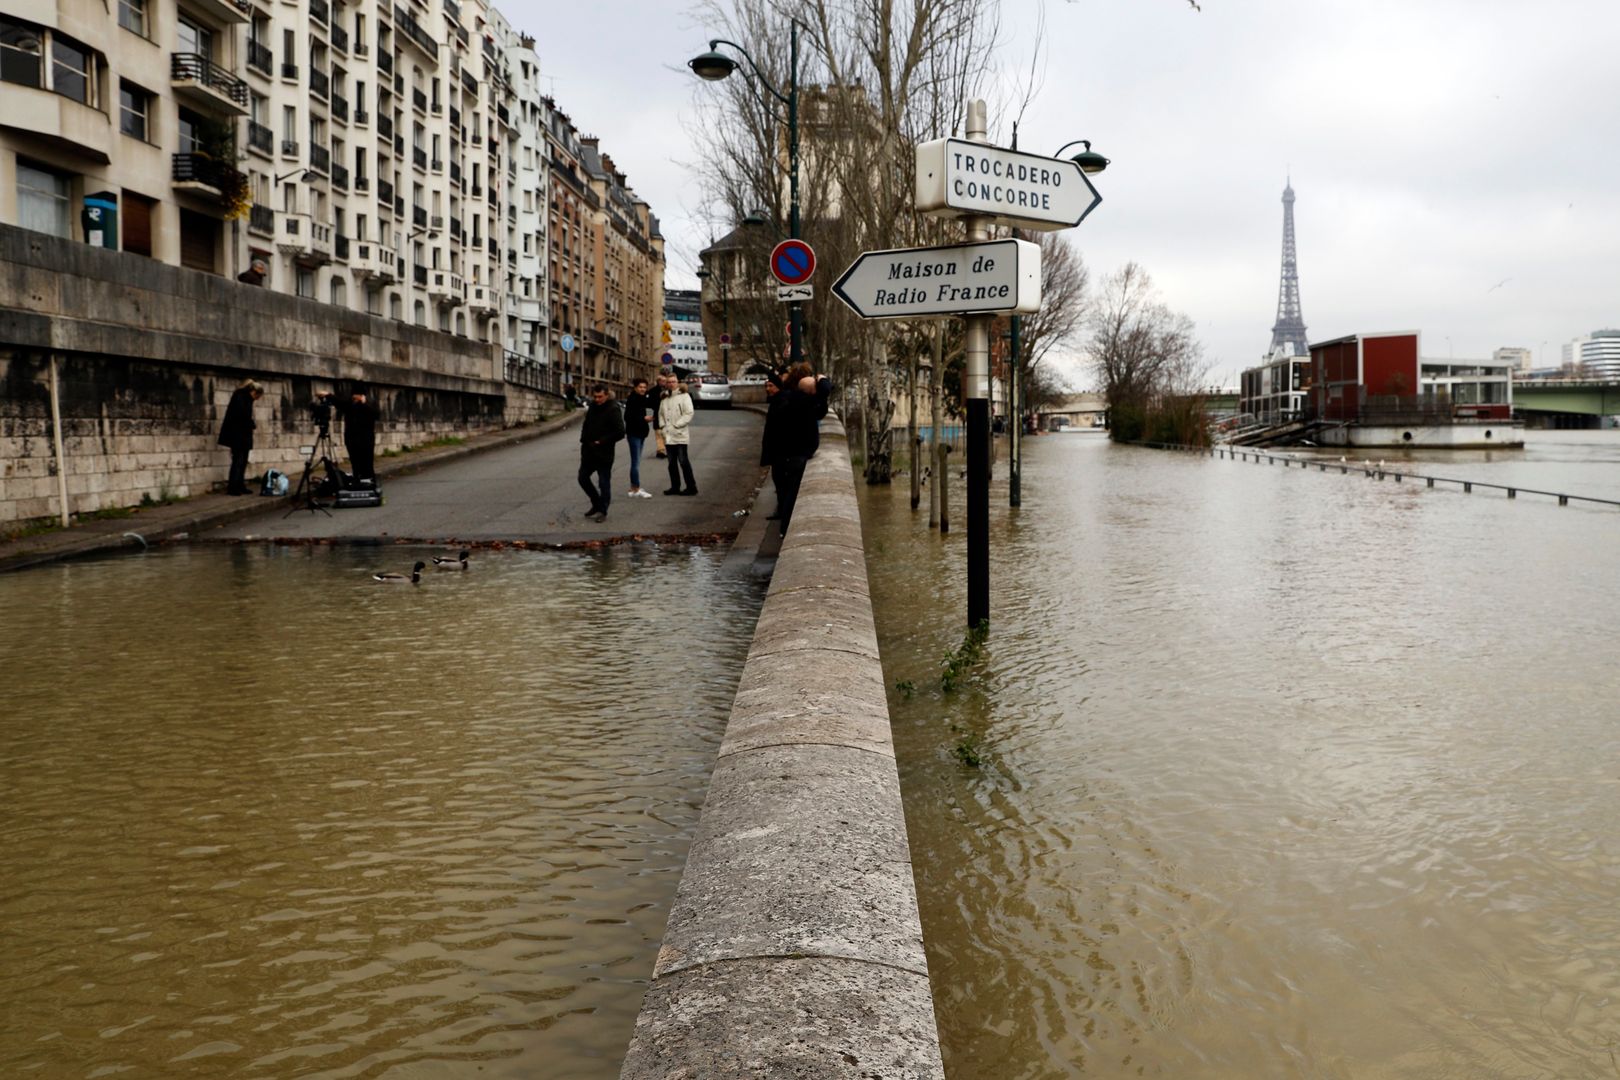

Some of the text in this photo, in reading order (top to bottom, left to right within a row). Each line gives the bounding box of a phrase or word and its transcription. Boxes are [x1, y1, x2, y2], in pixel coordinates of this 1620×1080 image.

[954, 153, 1061, 187] TROCADERO
[954, 179, 1050, 210] CONCORDE
[888, 256, 995, 280] Maison de
[874, 284, 1009, 306] Radio France
